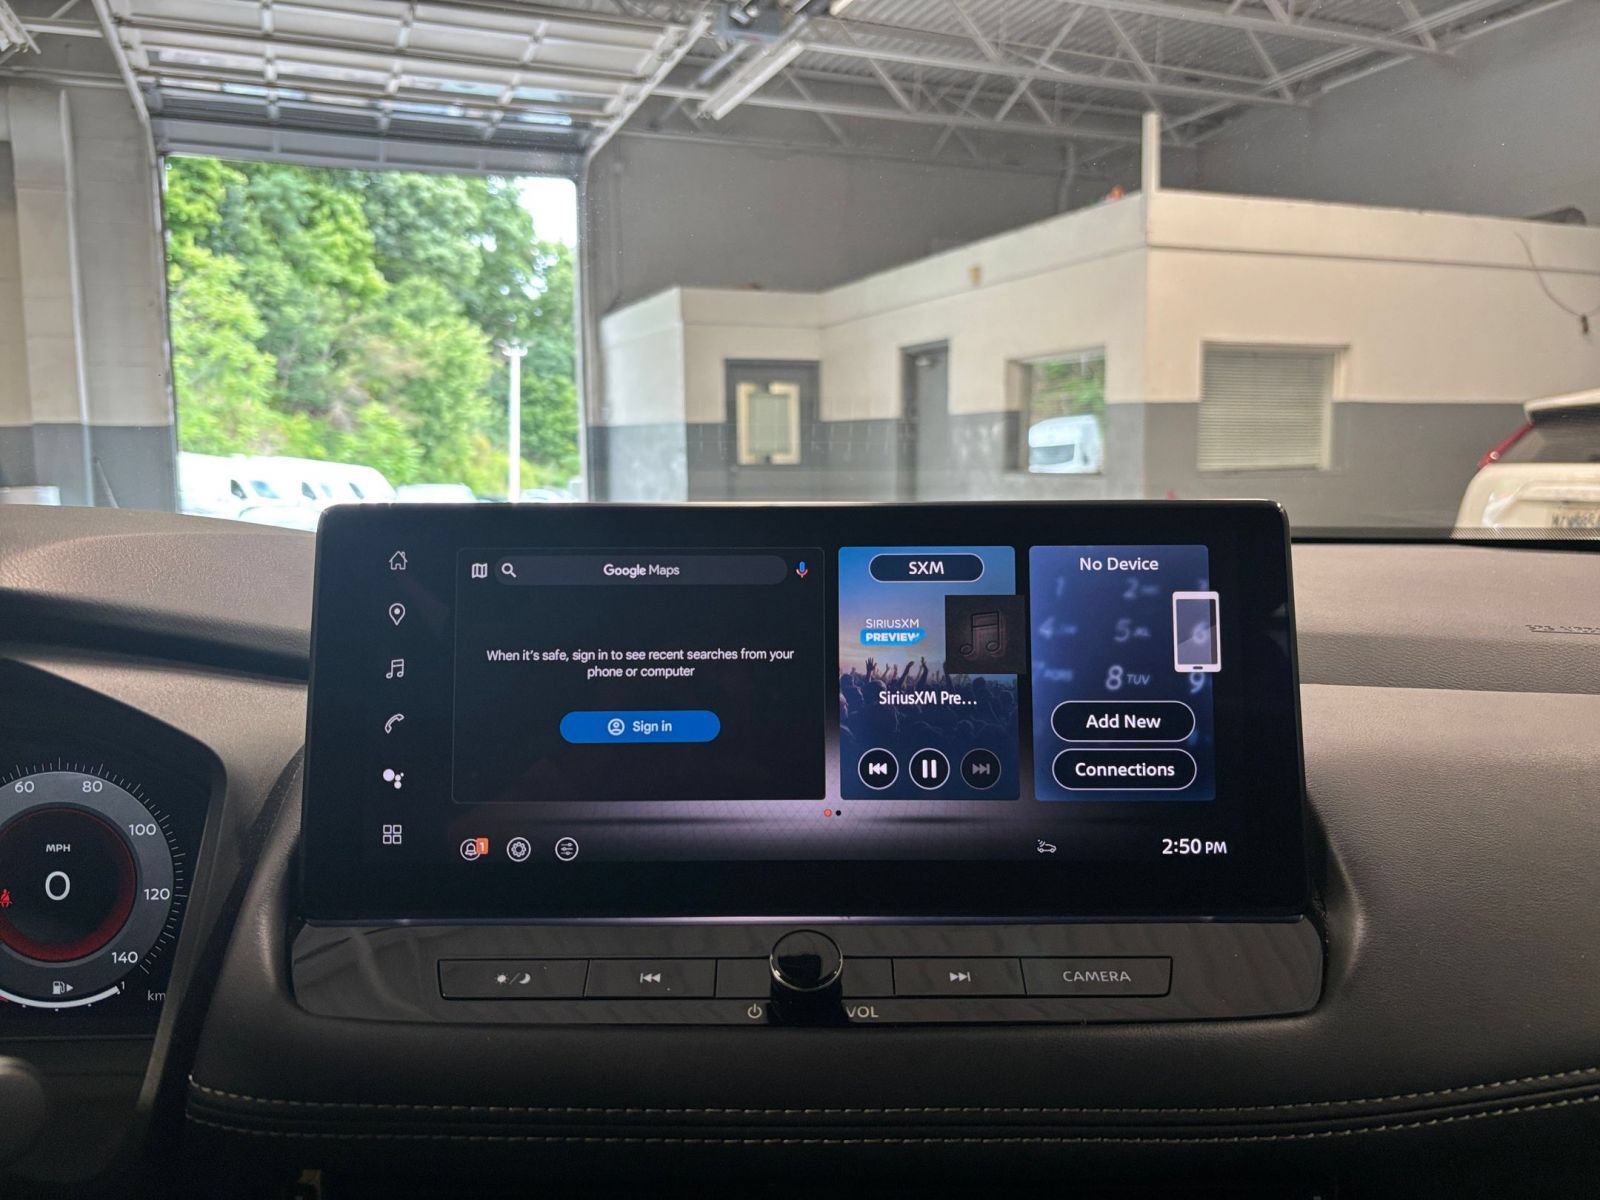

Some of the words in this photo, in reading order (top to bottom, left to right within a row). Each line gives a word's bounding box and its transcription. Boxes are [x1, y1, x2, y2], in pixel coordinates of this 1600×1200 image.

[603, 564, 646, 577] Google
[648, 564, 680, 577] Maps
[908, 561, 945, 575] SXM
[1079, 557, 1102, 571] No
[1107, 557, 1159, 571] Device
[865, 618, 920, 629] SIRIUSXM
[865, 632, 920, 642] PREVIEW
[486, 650, 520, 661] When
[542, 649, 569, 662] safe,
[572, 649, 596, 663] sign
[598, 649, 609, 661] in
[611, 650, 623, 660] to
[625, 652, 646, 660] see
[648, 650, 684, 660] recent
[687, 648, 738, 660] searches
[740, 648, 767, 660] from
[769, 651, 794, 663] your
[587, 666, 623, 679] phone
[625, 669, 637, 677] or
[640, 666, 695, 679] computer
[879, 691, 936, 706] SiriusXM
[632, 720, 660, 734] Sign
[661, 720, 673, 732] in
[1085, 714, 1120, 729] Add
[1124, 714, 1161, 729] New
[1074, 762, 1175, 777] Connections
[14, 781, 35, 793] 60
[82, 781, 103, 793] 80
[128, 824, 157, 836] 100
[46, 843, 71, 852] MPH
[1162, 838, 1202, 854] 2:50
[1205, 841, 1228, 854] PM
[144, 888, 170, 900] 120
[111, 951, 138, 963] 140
[1062, 970, 1131, 983] CAMERA
[846, 1006, 879, 1018] VOL
